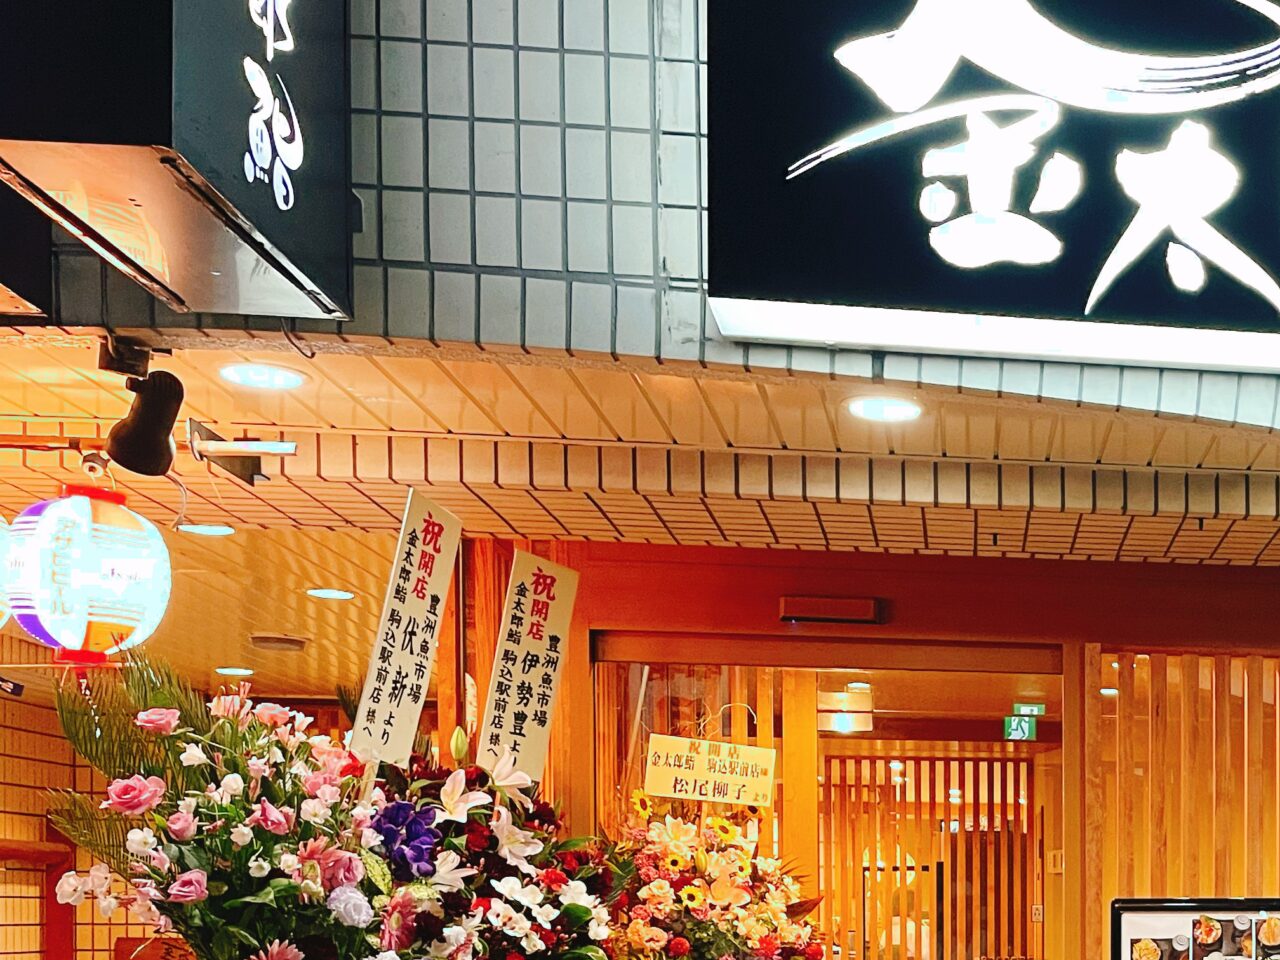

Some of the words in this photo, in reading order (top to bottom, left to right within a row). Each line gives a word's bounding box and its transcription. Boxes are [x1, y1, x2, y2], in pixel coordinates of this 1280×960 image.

[411, 511, 444, 601] 祝開店
[407, 593, 441, 704] 豊洲魚市場
[526, 566, 557, 642] 祝開店
[531, 634, 561, 728] 豊洲魚市場
